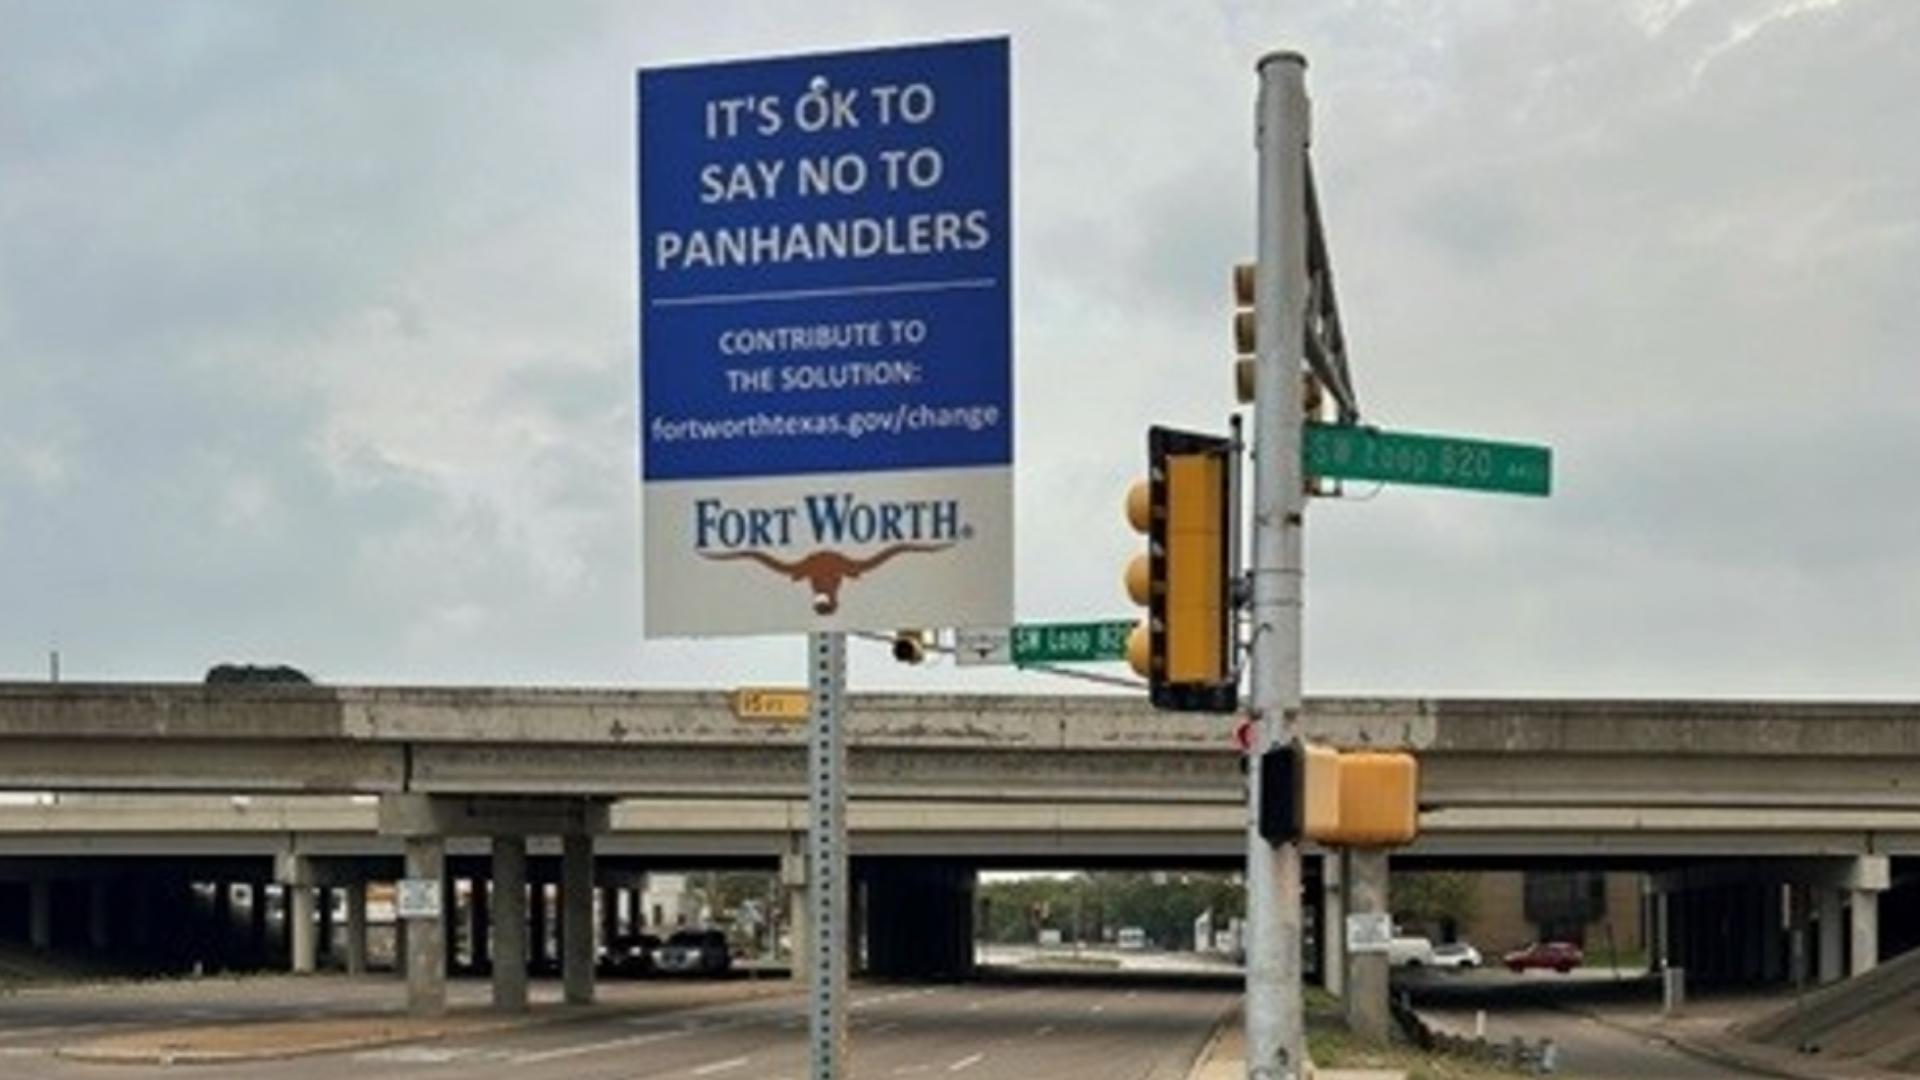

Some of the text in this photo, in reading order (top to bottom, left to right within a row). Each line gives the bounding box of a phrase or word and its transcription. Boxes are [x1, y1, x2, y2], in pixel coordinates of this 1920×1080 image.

[705, 82, 935, 139] IT'S OK TO
[700, 147, 942, 204] SAY NO TO
[656, 209, 990, 270] PANHANDLERS
[718, 319, 926, 355] CONTRIBUTE TO
[726, 362, 922, 394] THE SOLUTION:
[651, 402, 999, 443] fortworthtexas.gov/change
[1439, 444, 1492, 479] 820
[1016, 626, 1041, 654] SW
[1047, 628, 1091, 655] Loop
